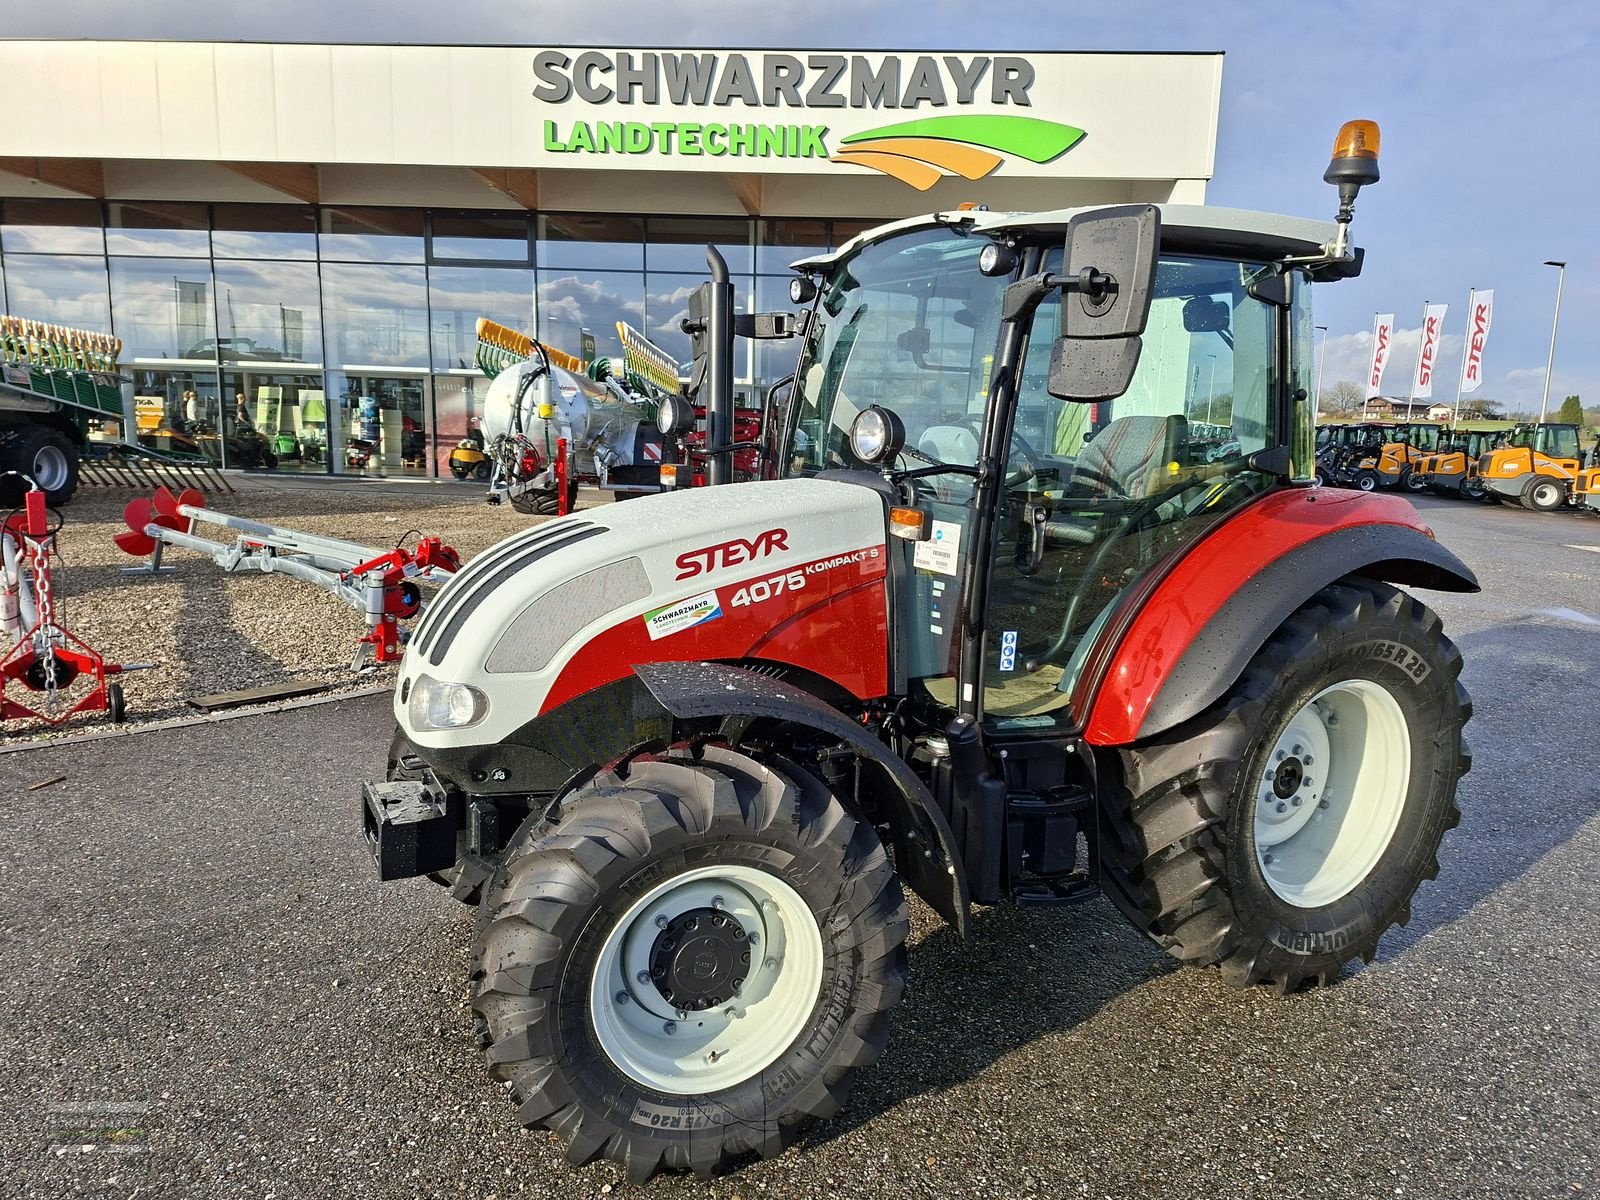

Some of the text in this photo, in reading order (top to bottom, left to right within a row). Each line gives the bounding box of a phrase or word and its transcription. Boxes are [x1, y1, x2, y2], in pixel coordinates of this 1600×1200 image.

[532, 50, 1036, 108] SCHWARZMAYR
[543, 119, 831, 158] LANDTECHNIK
[1371, 324, 1389, 388] STEYR
[1419, 316, 1438, 387] STEYR
[1466, 303, 1487, 382] STEYR
[674, 527, 790, 582] STEYR
[730, 570, 806, 609] 4075
[805, 551, 867, 575] KOMPAKT
[870, 548, 879, 558] S
[652, 600, 709, 625] SCHWARZMAYR
